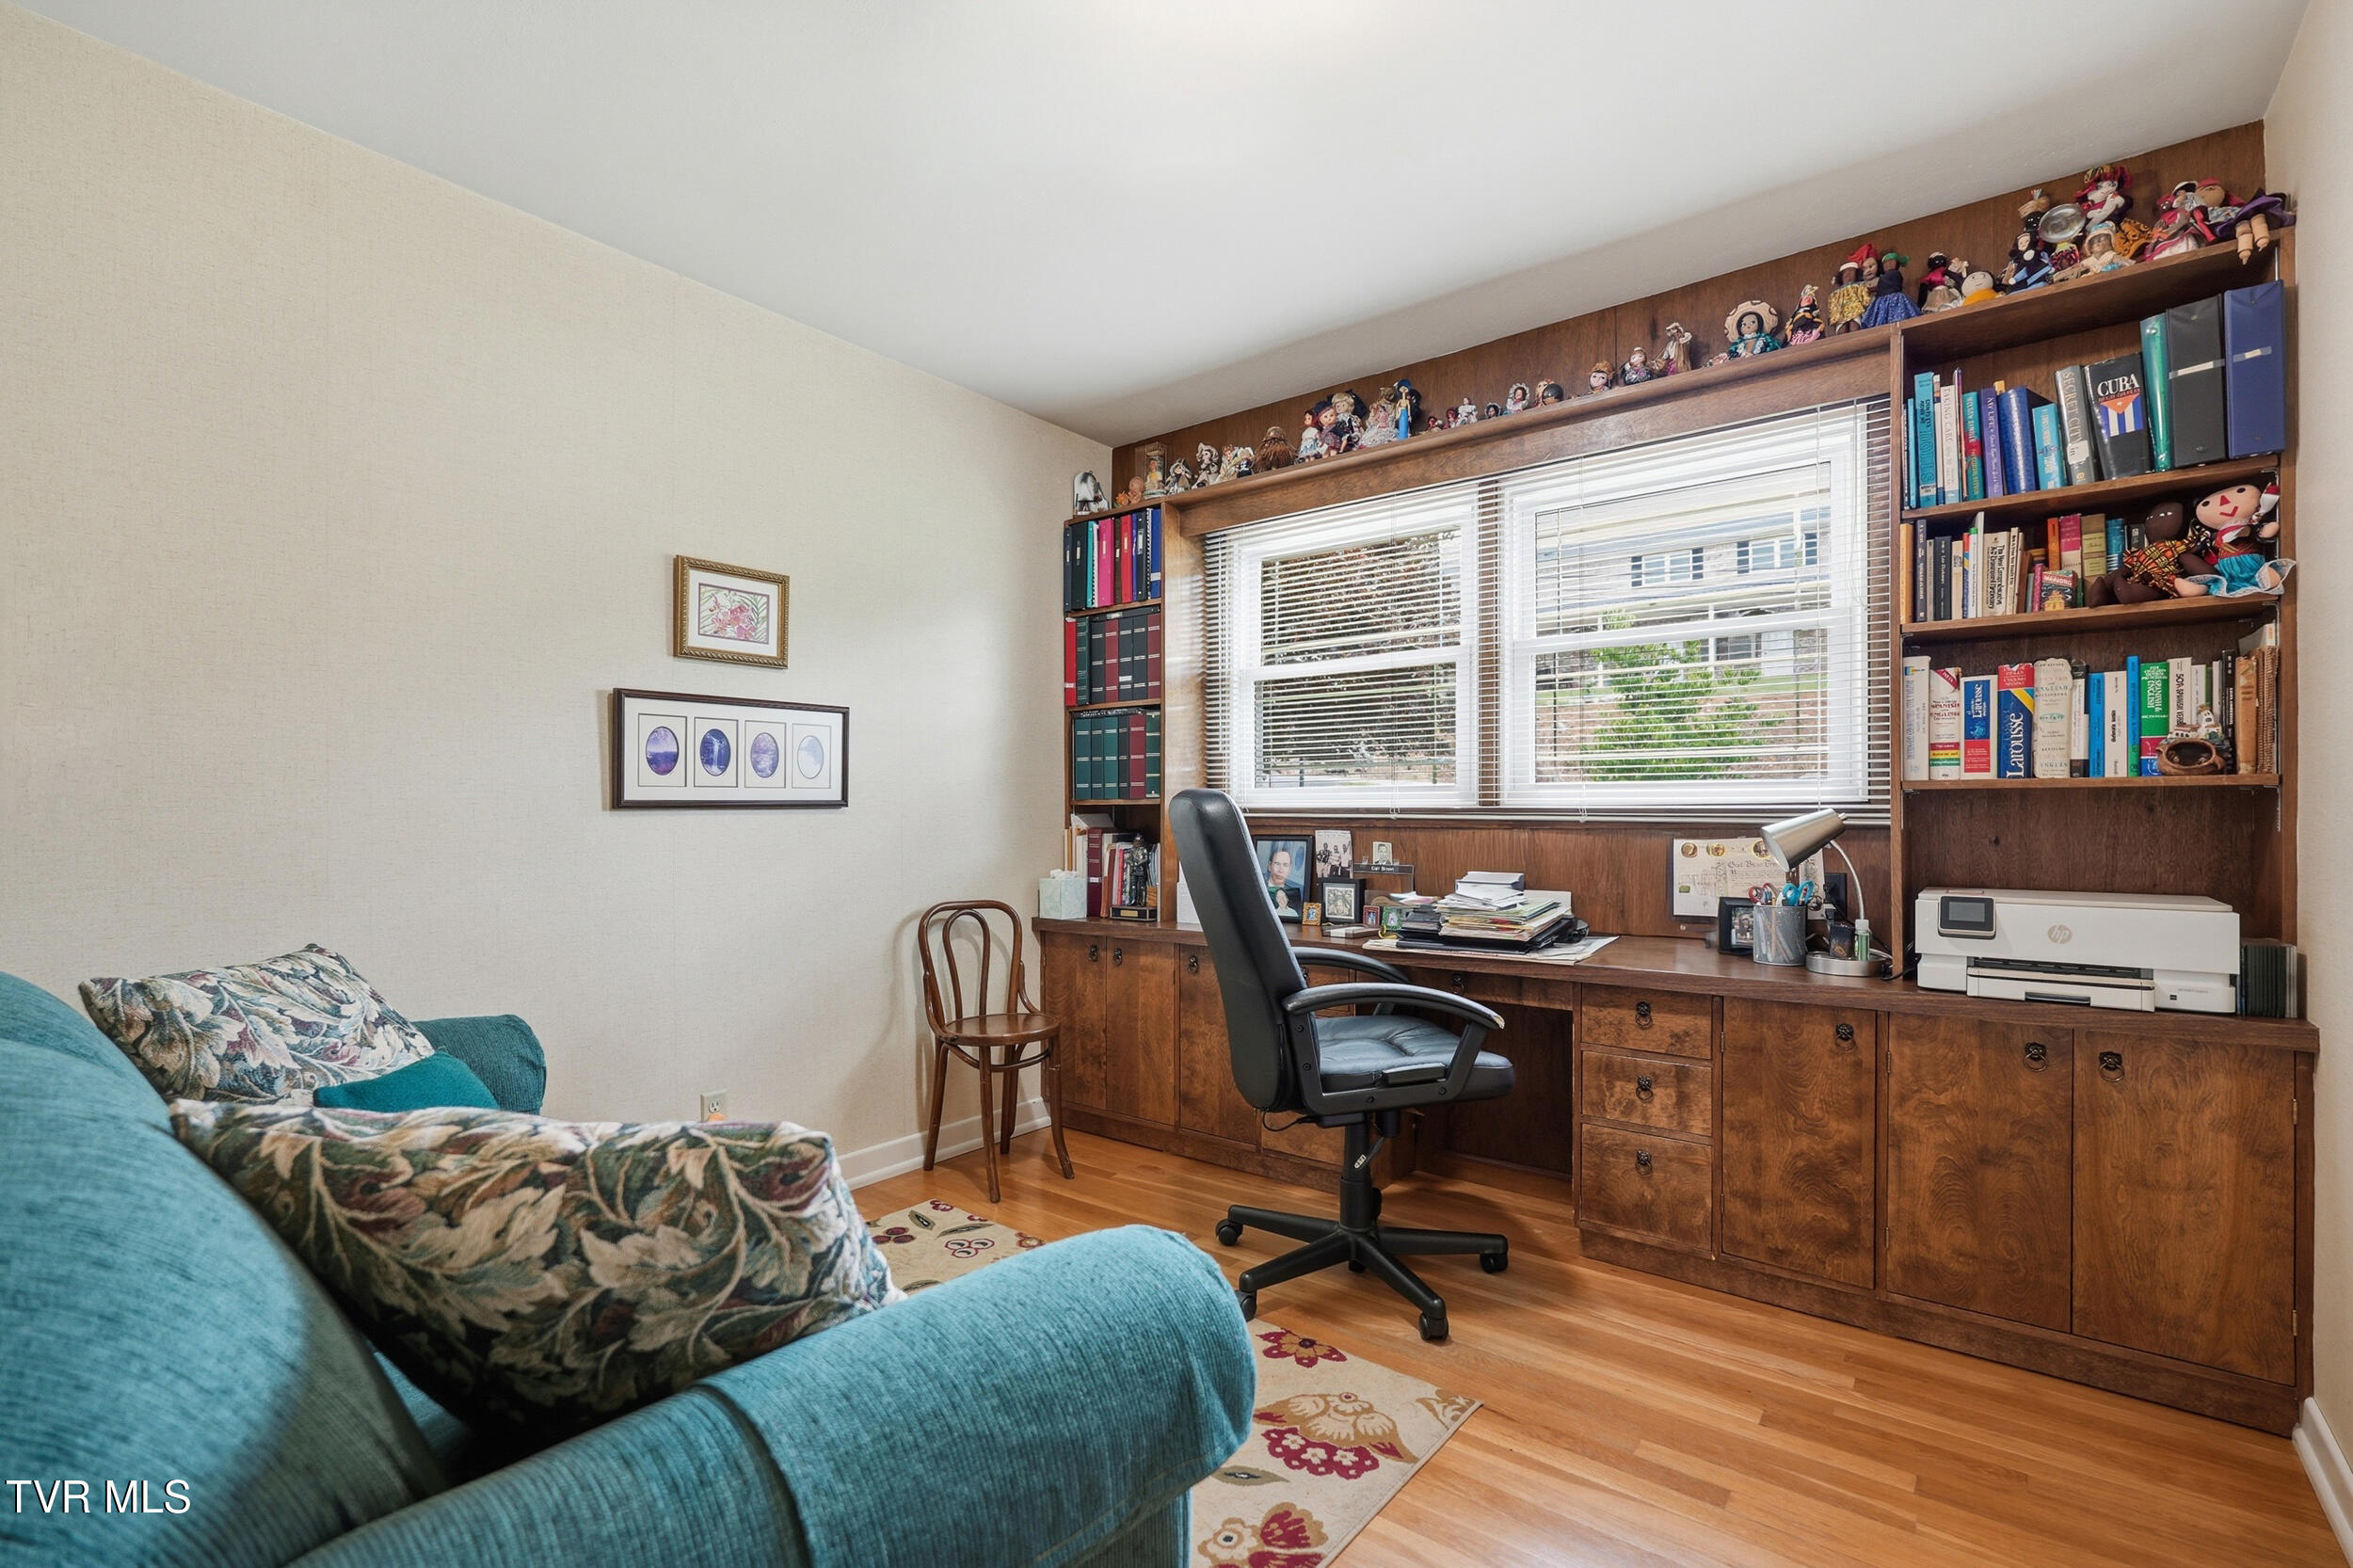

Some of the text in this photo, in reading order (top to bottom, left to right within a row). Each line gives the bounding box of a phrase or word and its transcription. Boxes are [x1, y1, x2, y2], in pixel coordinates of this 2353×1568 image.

[2062, 372, 2079, 414] SECRET
[2097, 373, 2141, 397] CUBA
[2006, 712, 2025, 778] Larousse
[2050, 925, 2071, 944] hp
